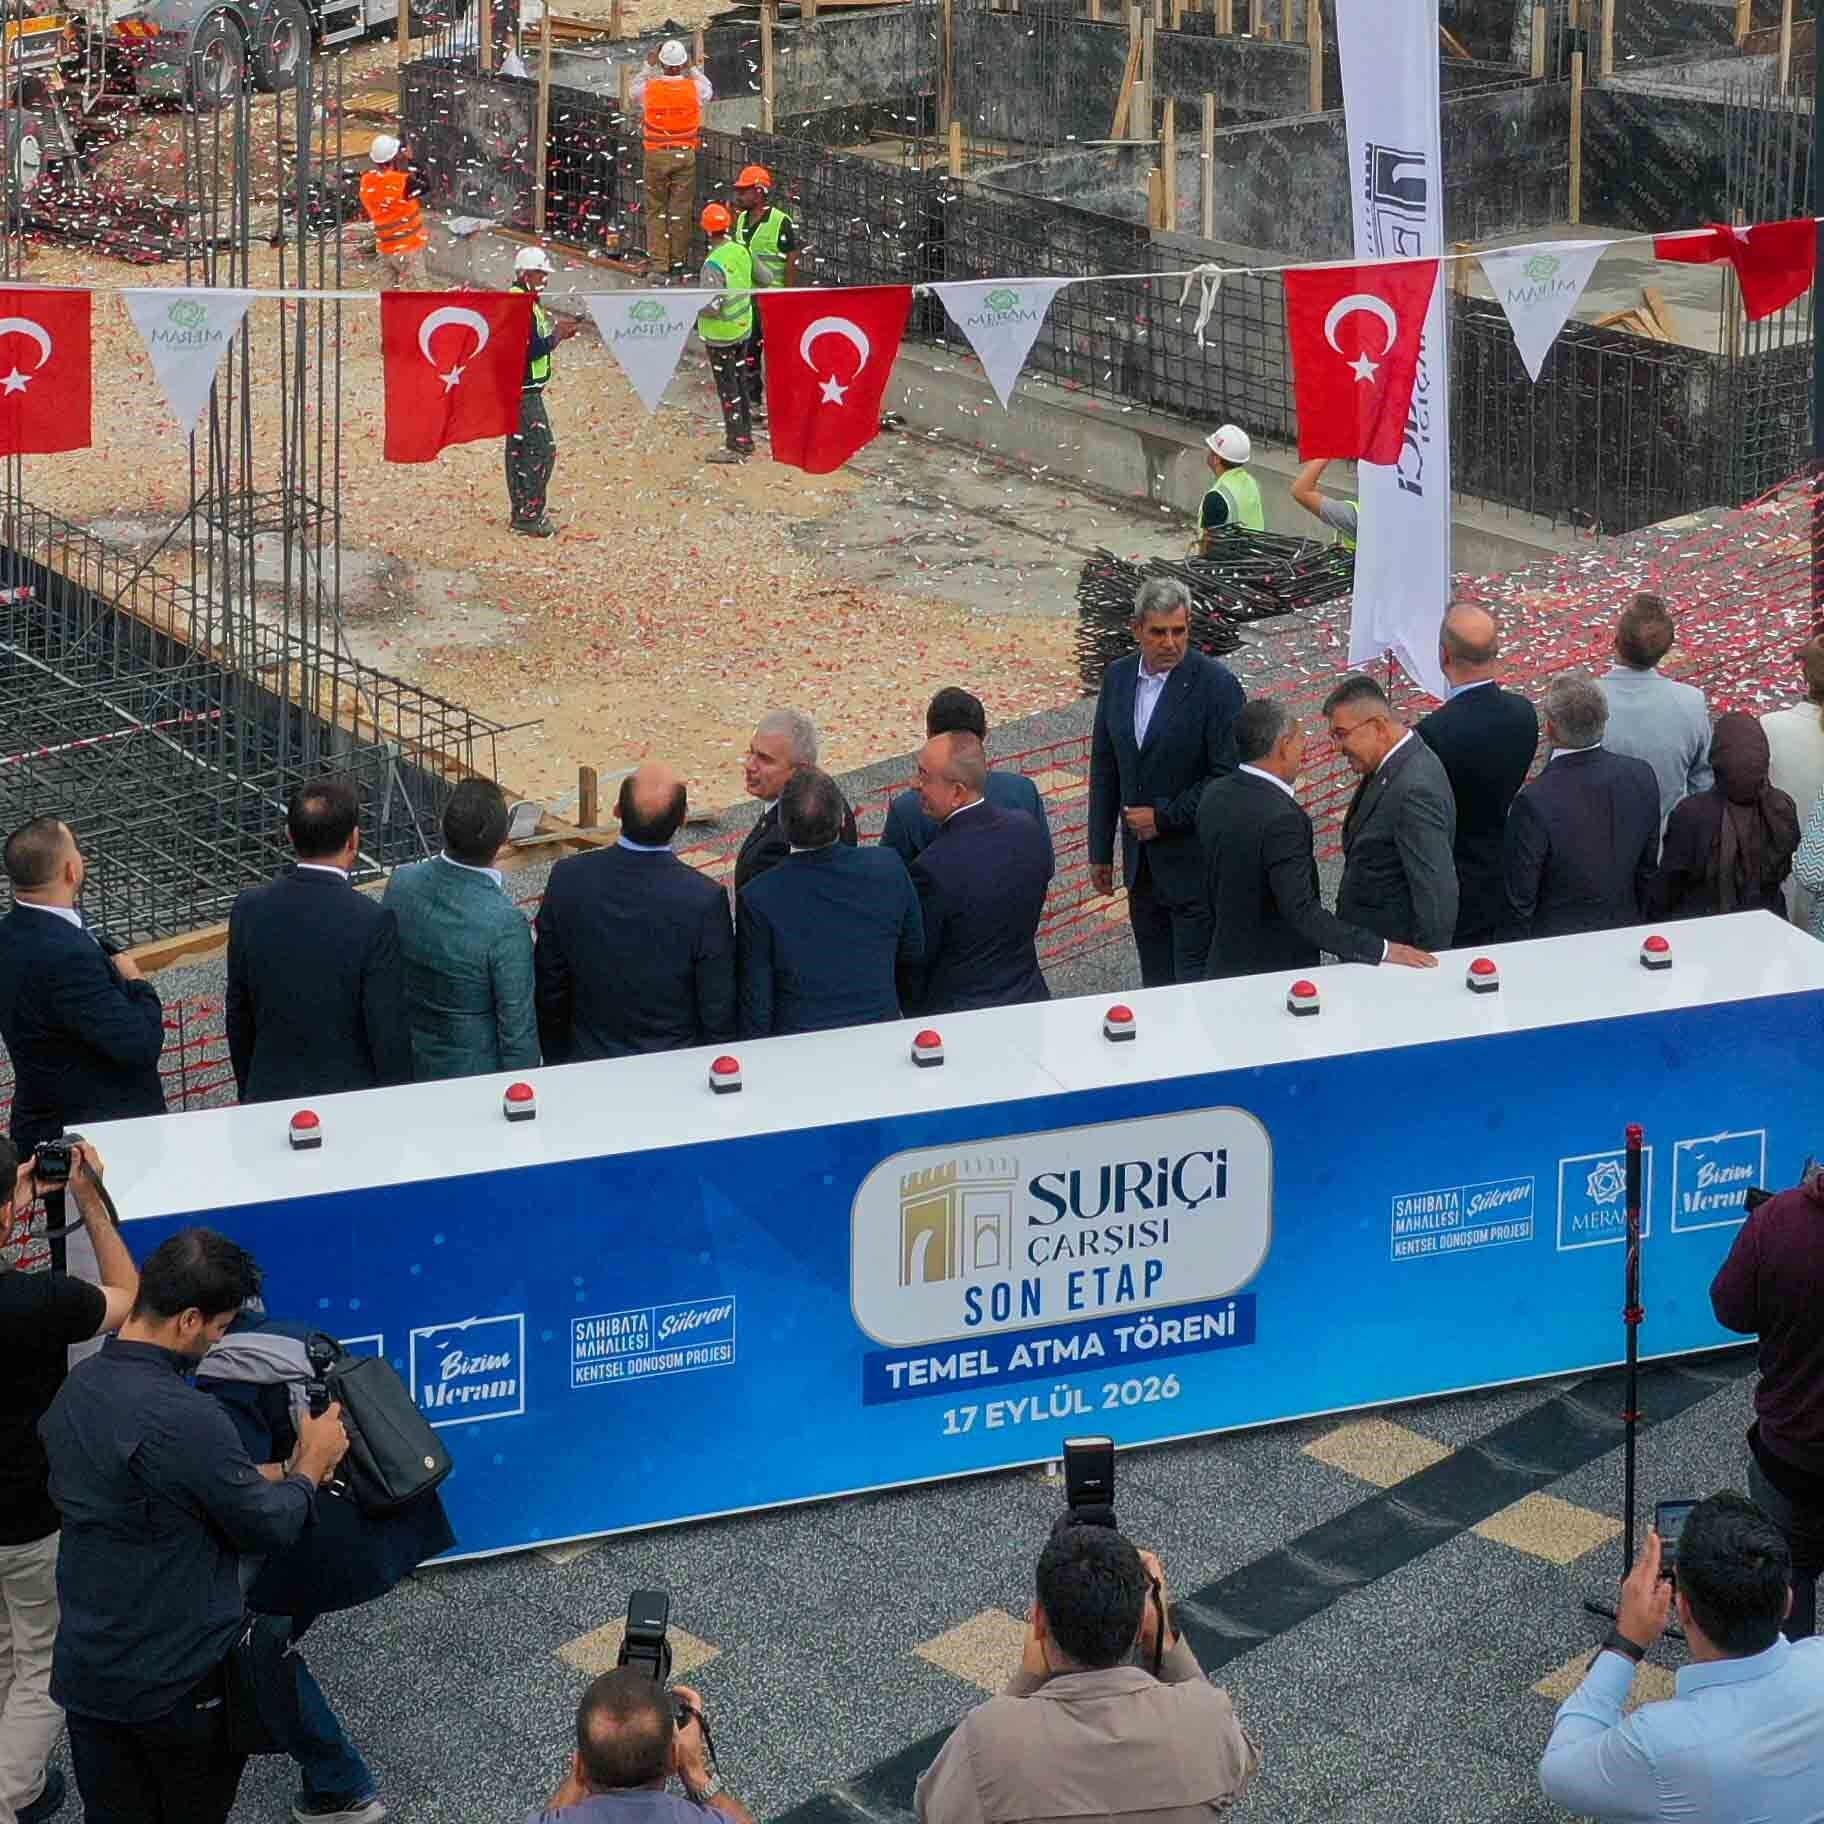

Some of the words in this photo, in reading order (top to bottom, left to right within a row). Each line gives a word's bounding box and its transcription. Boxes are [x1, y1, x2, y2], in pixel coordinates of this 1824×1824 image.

[1027, 1148, 1228, 1226] SURİÇİ
[1697, 1162, 1753, 1189] Bizim
[1467, 1183, 1531, 1217] Şükran
[1572, 1208, 1627, 1232] MERA
[1027, 1217, 1170, 1267] ÇARŞISI
[1395, 1237, 1437, 1257] KENTSEL
[964, 1277, 1042, 1326] SON
[1068, 1259, 1164, 1312] ETAP
[658, 1304, 732, 1341] Şükran
[885, 1349, 999, 1389] TEMEL
[1007, 1332, 1105, 1372] ATMA
[1114, 1302, 1237, 1351] TÖRENİ
[440, 1351, 512, 1381] Bizim
[575, 1361, 625, 1384] KENTSEL
[419, 1379, 516, 1409] Meram
[943, 1406, 976, 1436] 17
[985, 1384, 1092, 1430] EYLÜL
[1102, 1374, 1181, 1411] 2026
